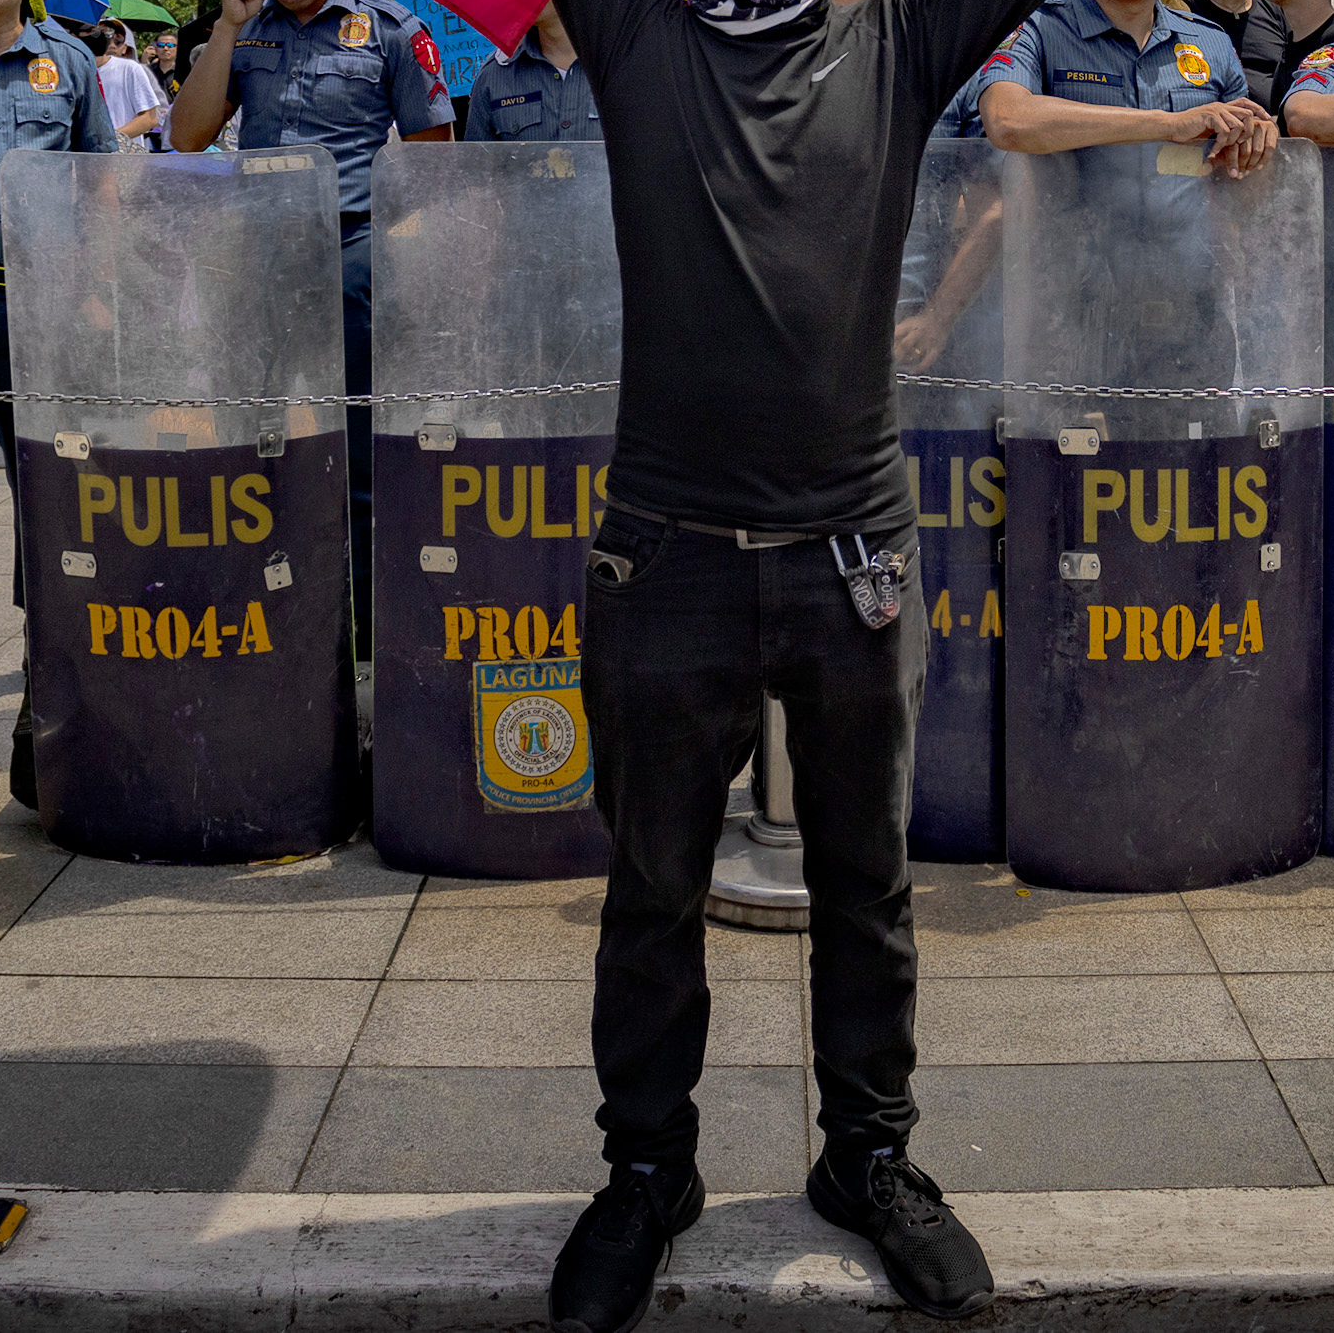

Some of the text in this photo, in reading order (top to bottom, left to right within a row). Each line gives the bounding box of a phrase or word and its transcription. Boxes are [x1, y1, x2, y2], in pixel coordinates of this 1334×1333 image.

[235, 40, 276, 48] MONTILLA
[1066, 71, 1107, 83] PESIRLA
[501, 96, 525, 107] DAVID
[907, 456, 1006, 528] LIS
[78, 473, 273, 548] PULIS
[1082, 465, 1269, 543] PULIS
[931, 589, 1003, 638] 4-A
[87, 601, 273, 661] PRO4-A
[441, 603, 580, 661] PRO4
[1086, 599, 1264, 662] PRO4-A
[481, 666, 581, 689] LAGUNA
[508, 710, 531, 733] PROVINCE
[542, 711, 561, 731] LAGUNA
[514, 749, 557, 764] OFFICIAL SEAL
[486, 781, 584, 804] POLICE PROVINCIAL OFFICE
[522, 778, 554, 788] PRO-4A
